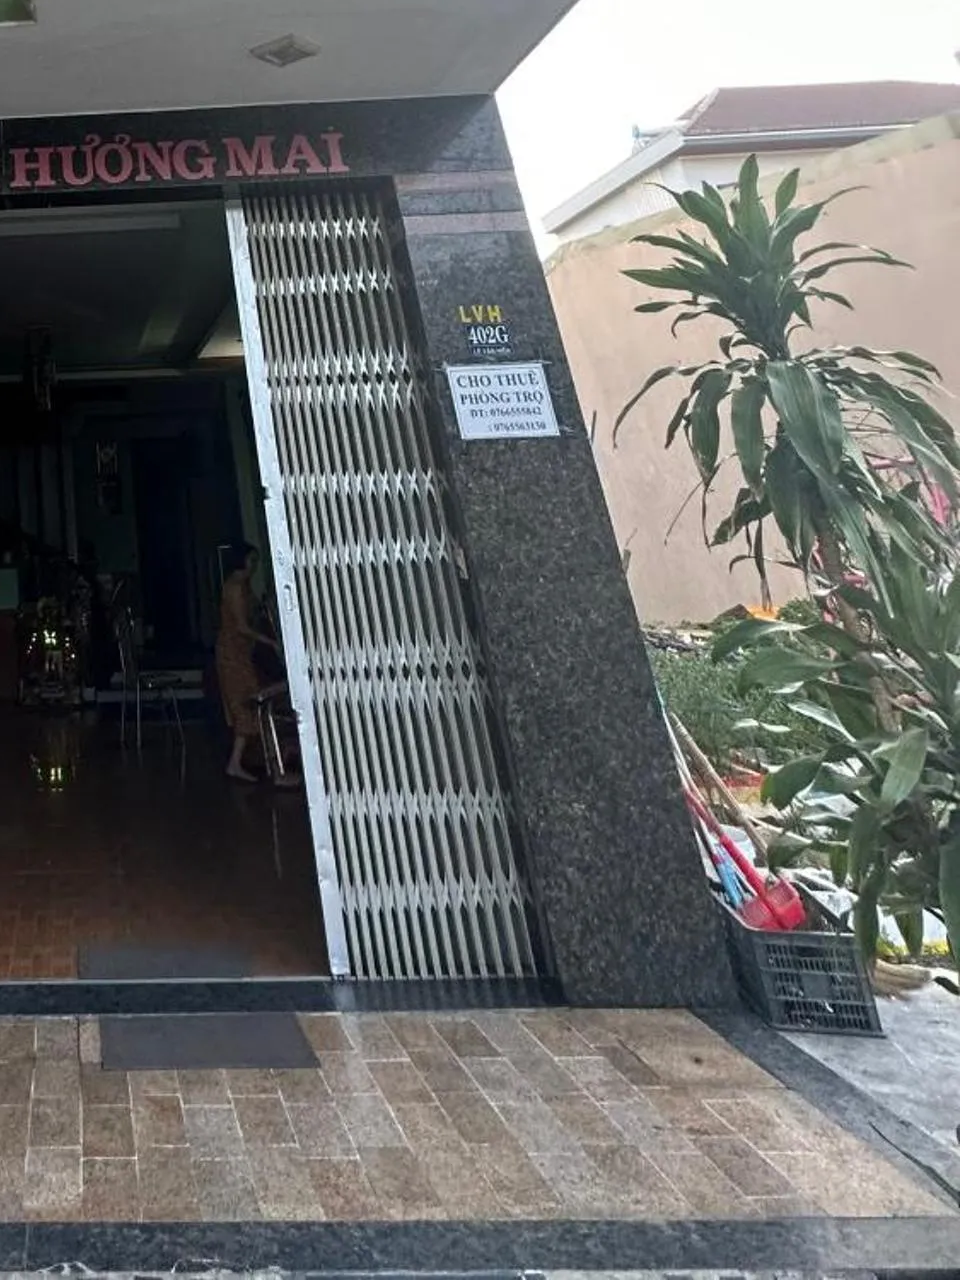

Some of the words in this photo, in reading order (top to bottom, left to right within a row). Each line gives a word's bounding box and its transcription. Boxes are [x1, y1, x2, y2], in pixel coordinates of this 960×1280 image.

[468, 325, 508, 344] 402G
[456, 374, 492, 388] CHO
[460, 389, 510, 405] PHÒNG
[513, 390, 544, 404] TRỌ
